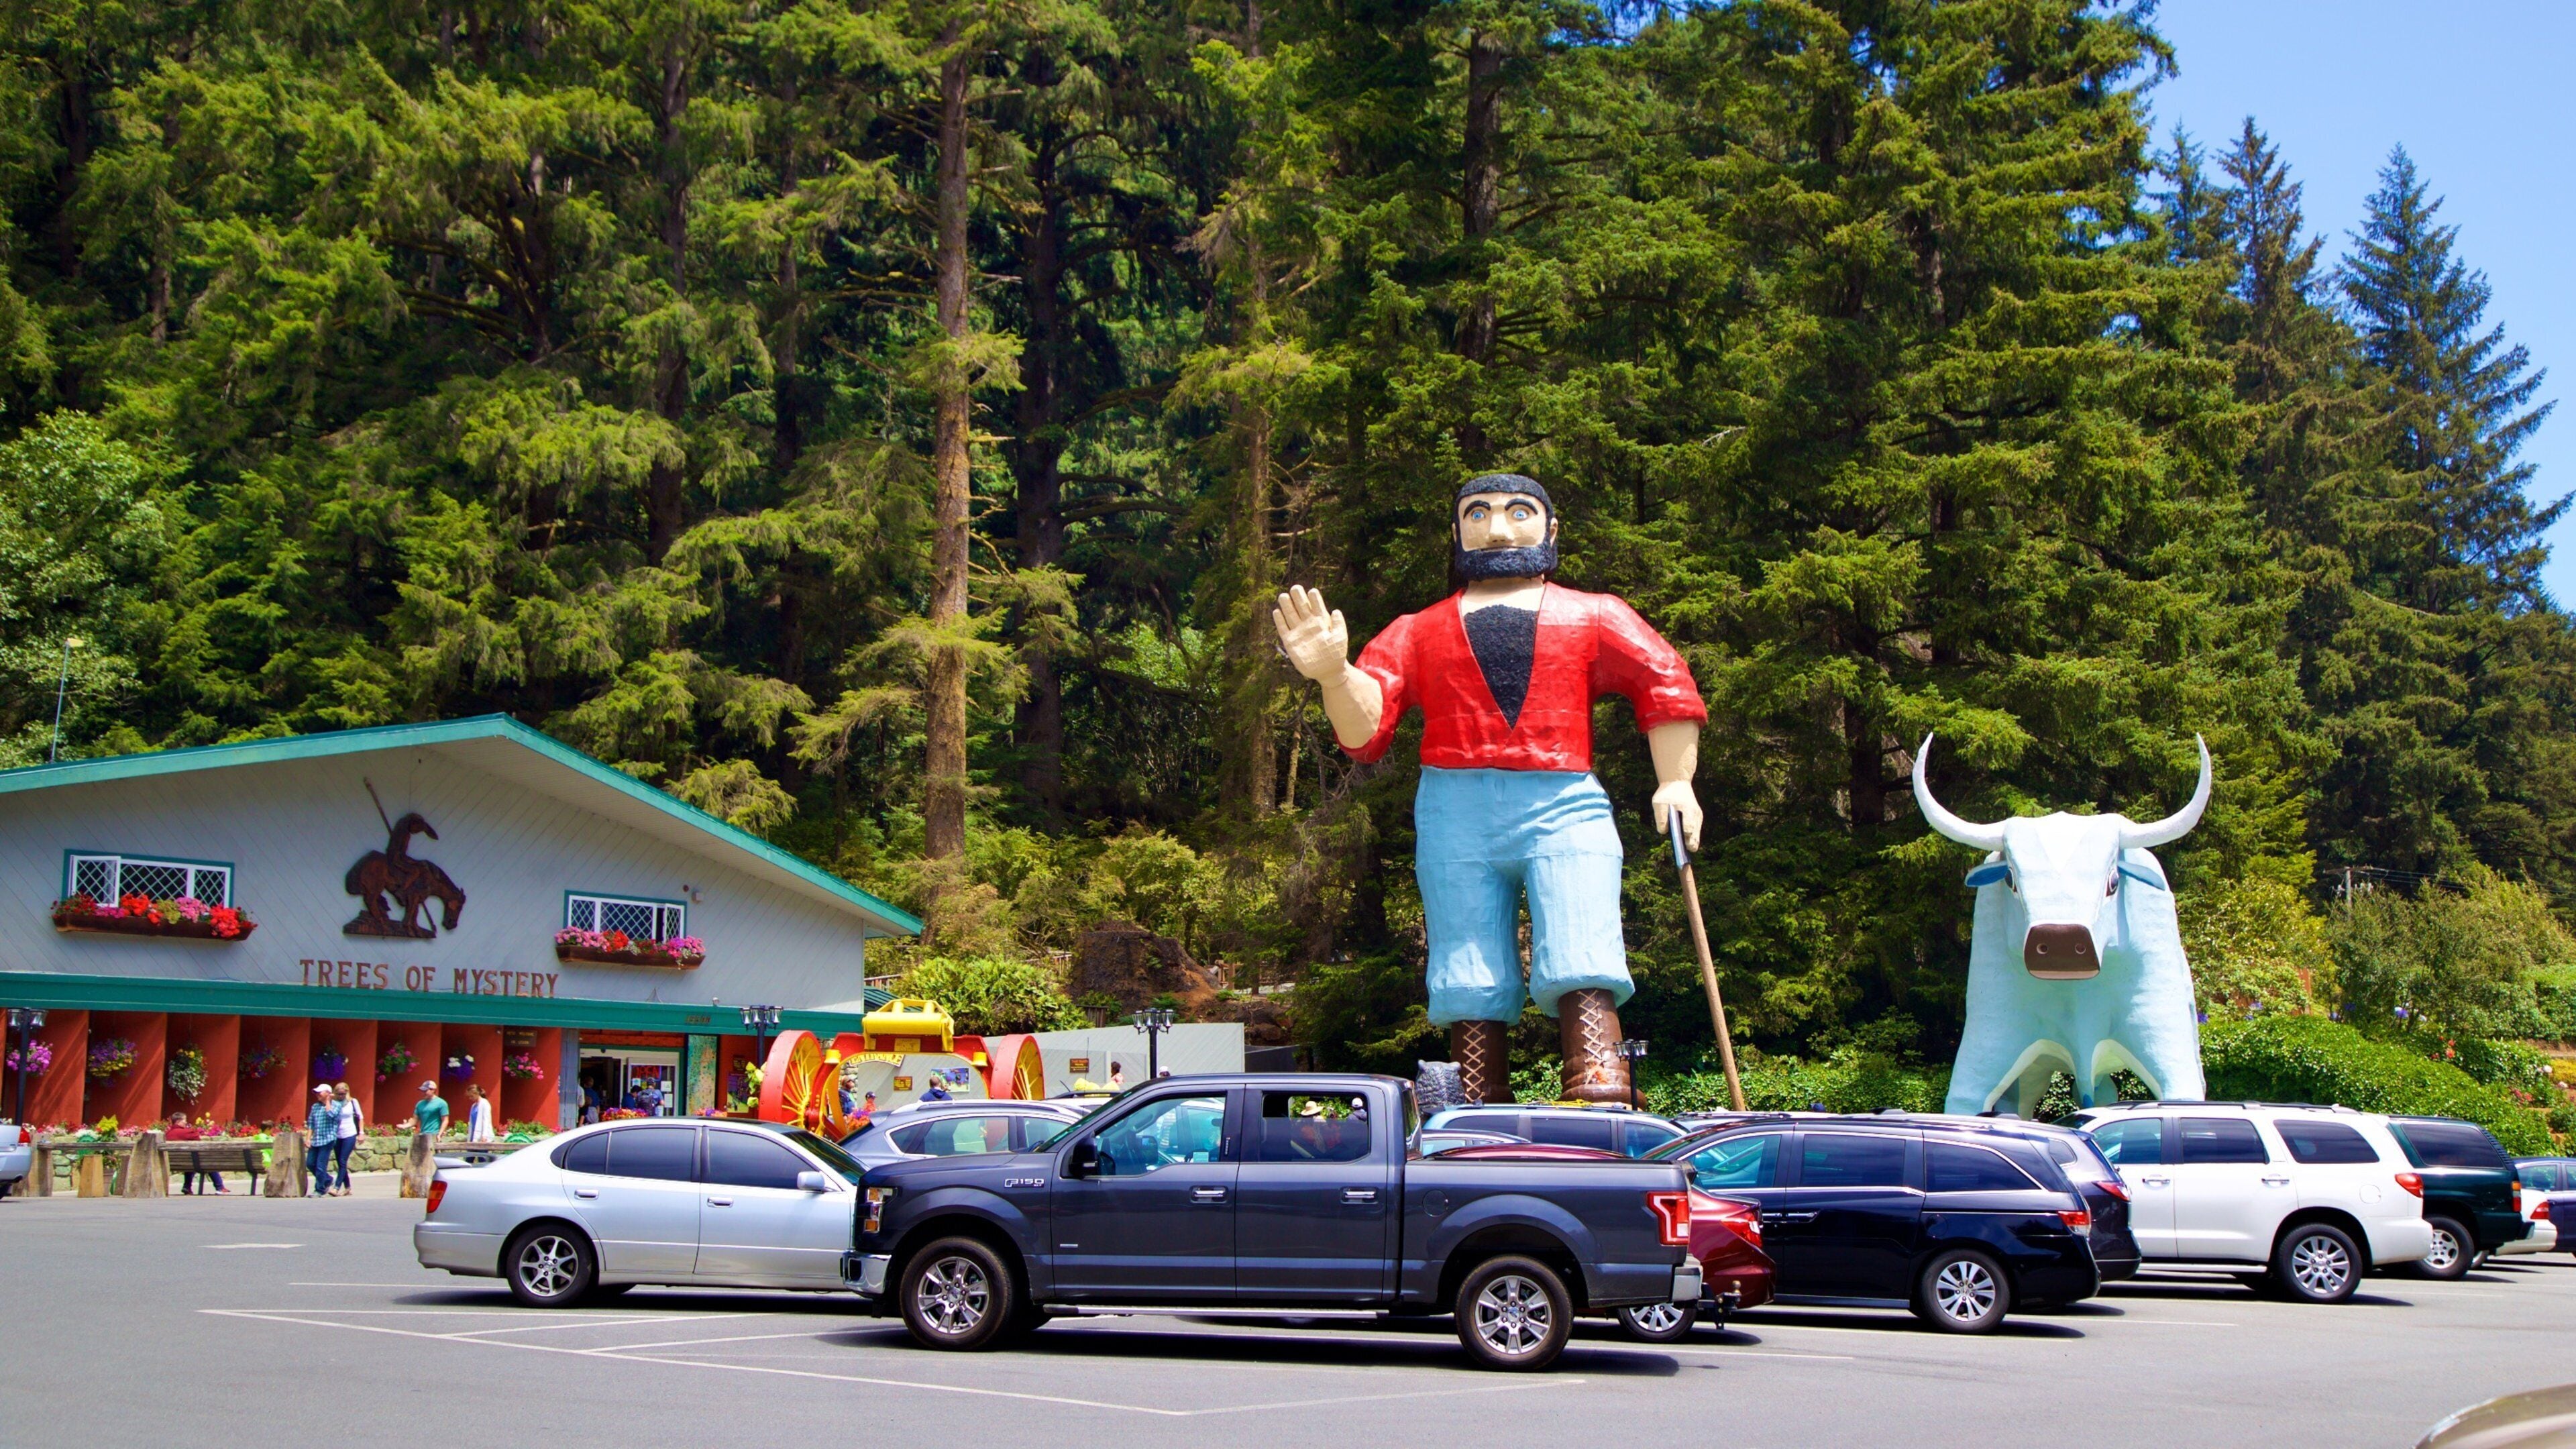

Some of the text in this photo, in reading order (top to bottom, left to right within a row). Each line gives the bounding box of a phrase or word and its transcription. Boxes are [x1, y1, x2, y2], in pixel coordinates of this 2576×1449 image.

[300, 959, 559, 998] TREES OF MYSTERY
